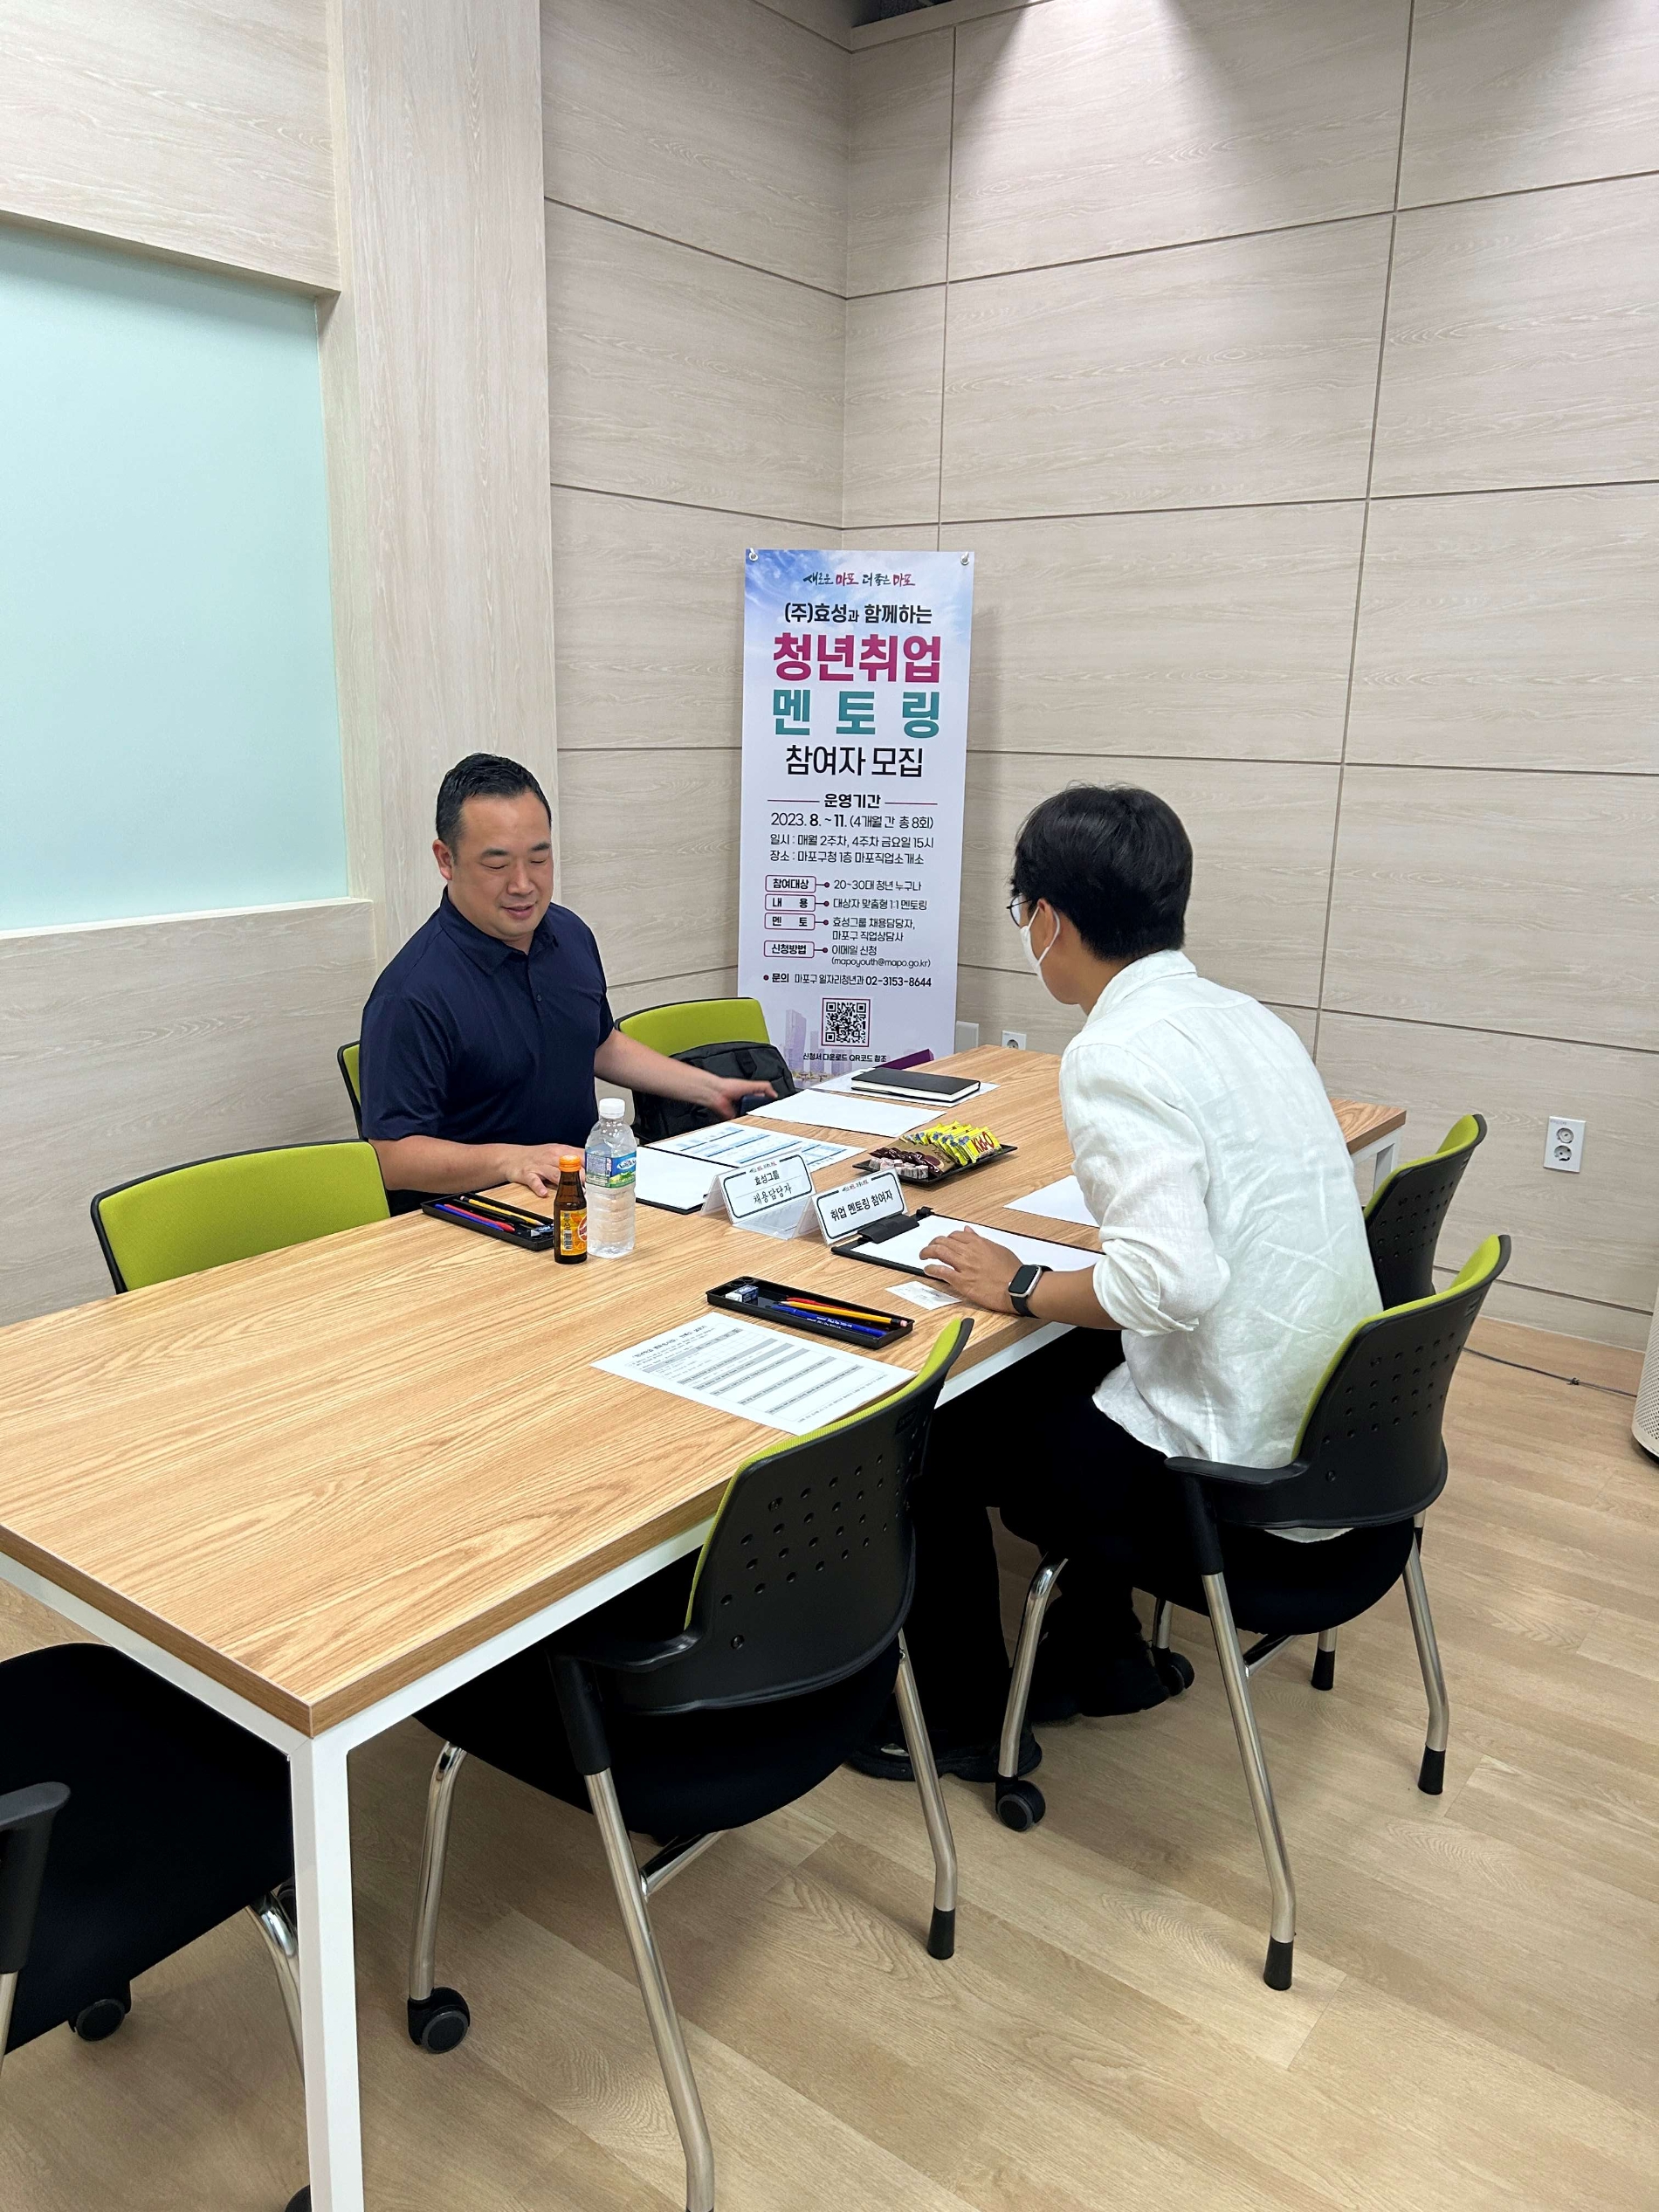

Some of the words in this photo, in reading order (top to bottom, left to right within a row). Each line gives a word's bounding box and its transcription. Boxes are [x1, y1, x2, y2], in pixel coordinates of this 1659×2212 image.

[802, 571, 834, 586] 새로운
[836, 572, 859, 586] 마포
[862, 572, 873, 586] 더
[874, 573, 891, 586] 좋은
[892, 573, 916, 587] 마포
[784, 603, 860, 624] (주)효성과
[864, 603, 933, 624] 함께하는
[773, 632, 941, 683] 청년취업
[786, 745, 866, 775] 참여자
[871, 748, 923, 777] 모집
[824, 794, 881, 809] 운영기간
[771, 812, 807, 826] 2023.
[809, 813, 822, 827] 8.
[834, 814, 847, 827] 11.
[898, 816, 910, 829] 총
[912, 817, 933, 829] 8회)
[798, 834, 818, 846] 매월
[820, 835, 850, 848] 2주차,
[852, 836, 879, 848] 4주차
[881, 837, 911, 848] 금요일
[913, 837, 934, 848] 15시
[798, 851, 837, 863] 마포구청
[839, 851, 852, 863] 1층
[855, 851, 924, 865] 마포직업소개소
[773, 879, 809, 890] 참여대상
[834, 879, 875, 890] 20~30대
[876, 880, 894, 891] 청년
[895, 881, 922, 891] 누구나
[833, 899, 860, 909] 대상자
[862, 899, 888, 910] 맞춤형
[900, 899, 927, 911] 멘토링
[833, 917, 867, 928] 효성그룹
[869, 918, 916, 930] 채용담당자,
[832, 930, 858, 941] 마포구
[860, 931, 904, 942] 직업상담사
[771, 943, 807, 954] 신청방법
[831, 945, 858, 956] 이메일
[860, 946, 878, 956] 신청
[831, 957, 931, 969] (mapoyouth@mapo.go.kr)
[772, 973, 789, 983] 문의
[795, 974, 818, 984] 마포구
[819, 975, 864, 986] 일자리청년과
[865, 976, 932, 988] 02-3153-8644
[803, 1052, 822, 1061] 신청서
[823, 1053, 848, 1062] 다운로드
[849, 1054, 873, 1063] QR코드
[753, 1182, 793, 1205] 채용담당자
[830, 1205, 847, 1222] 취업
[847, 1198, 871, 1216] 멘토링
[871, 1189, 893, 1207] 참여자
